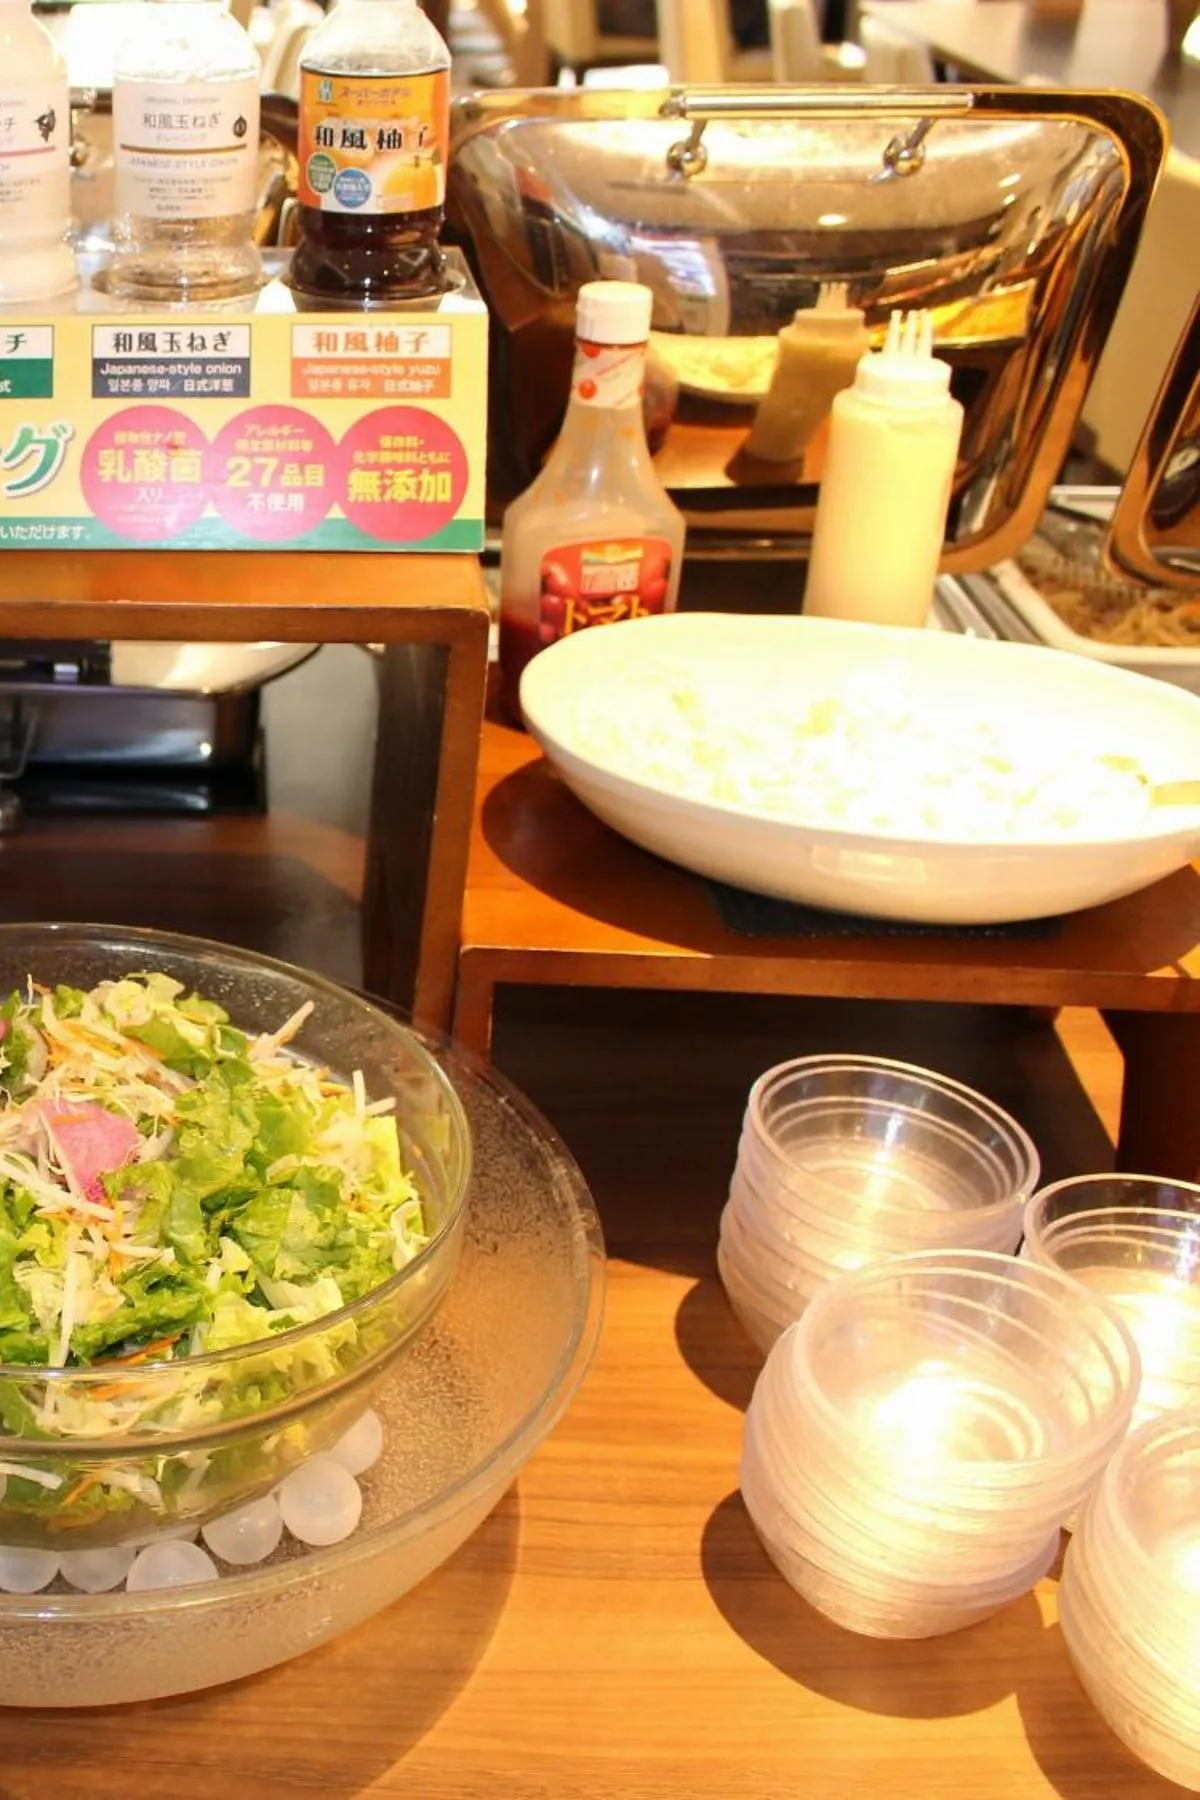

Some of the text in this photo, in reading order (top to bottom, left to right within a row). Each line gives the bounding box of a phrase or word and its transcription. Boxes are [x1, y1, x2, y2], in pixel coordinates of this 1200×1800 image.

[143, 111, 222, 129] 和風玉ねぎ
[314, 124, 429, 150] 和風柚子
[113, 330, 231, 353] 和風玉ねぎ
[312, 331, 430, 353] 和風柚子
[100, 362, 242, 376] Japanese-style onion
[301, 362, 442, 377] Japanese-style yuzu
[97, 448, 203, 484] 乳酸菌
[226, 456, 324, 487] 27品目
[347, 467, 452, 503] 無添加
[247, 492, 305, 512] 不使用
[561, 594, 650, 635] トマト
